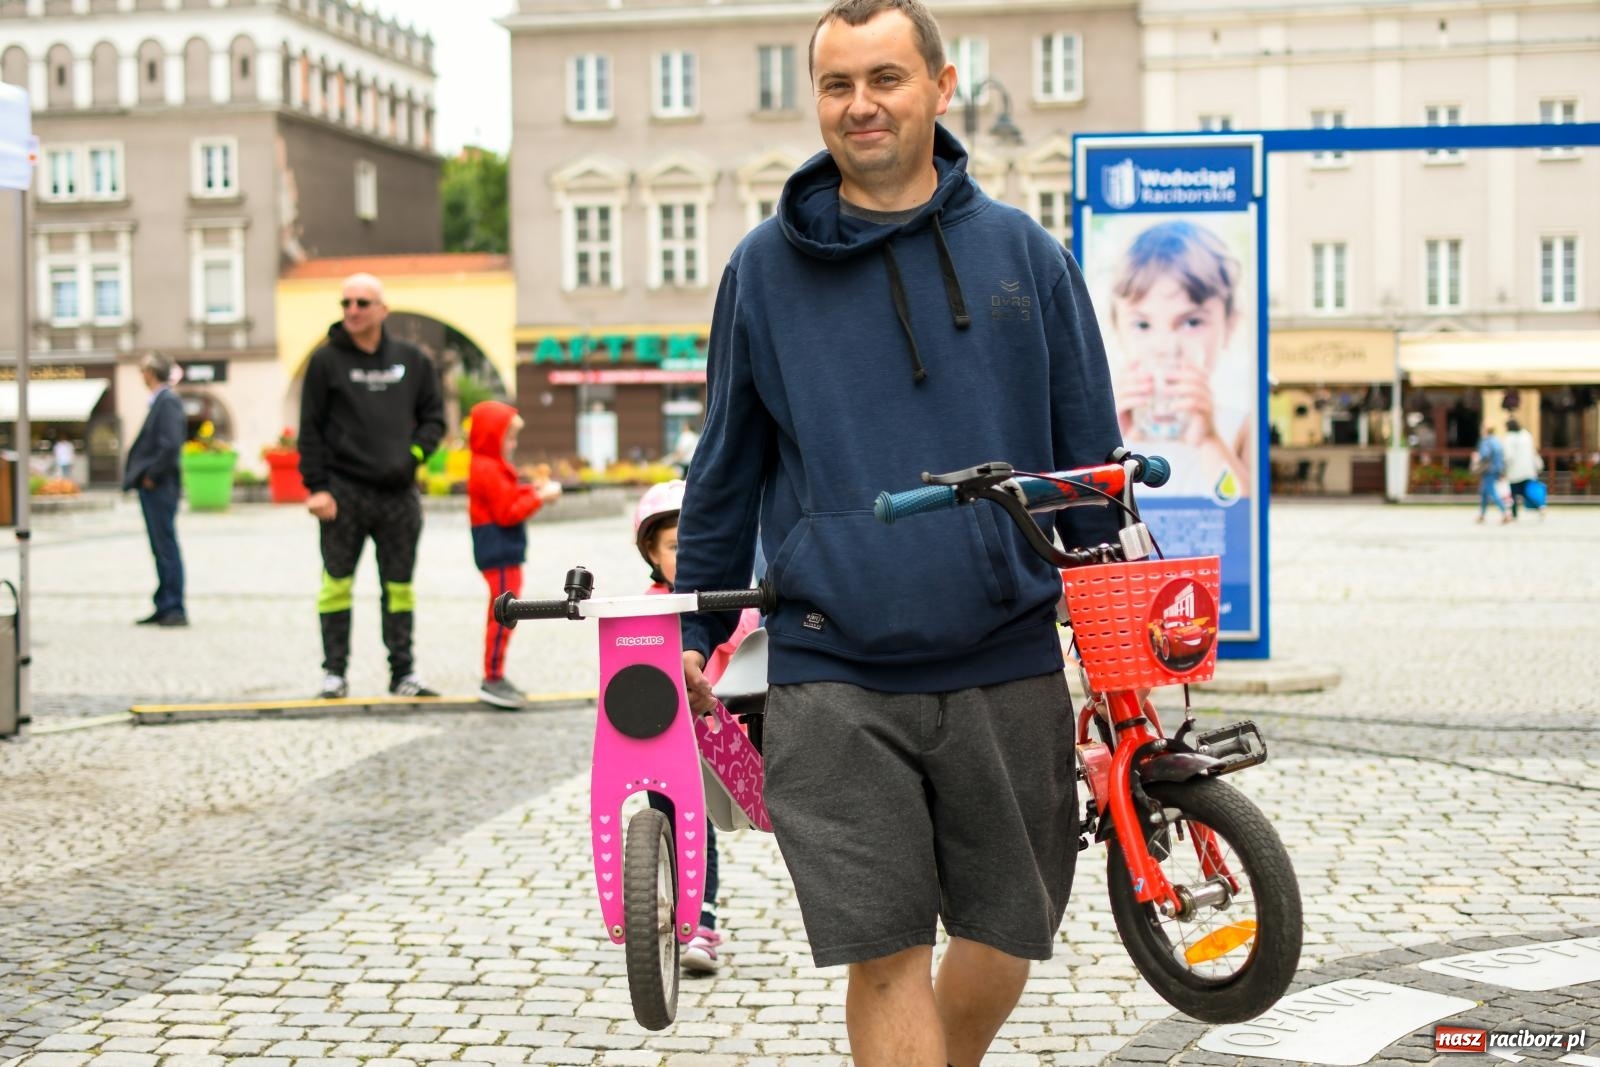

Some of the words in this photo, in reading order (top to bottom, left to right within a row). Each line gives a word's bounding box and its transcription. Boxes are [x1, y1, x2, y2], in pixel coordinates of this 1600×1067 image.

[532, 331, 708, 365] APTEK
[615, 635, 665, 647] RICOKIDS
[1223, 986, 1393, 1047] OPAVA
